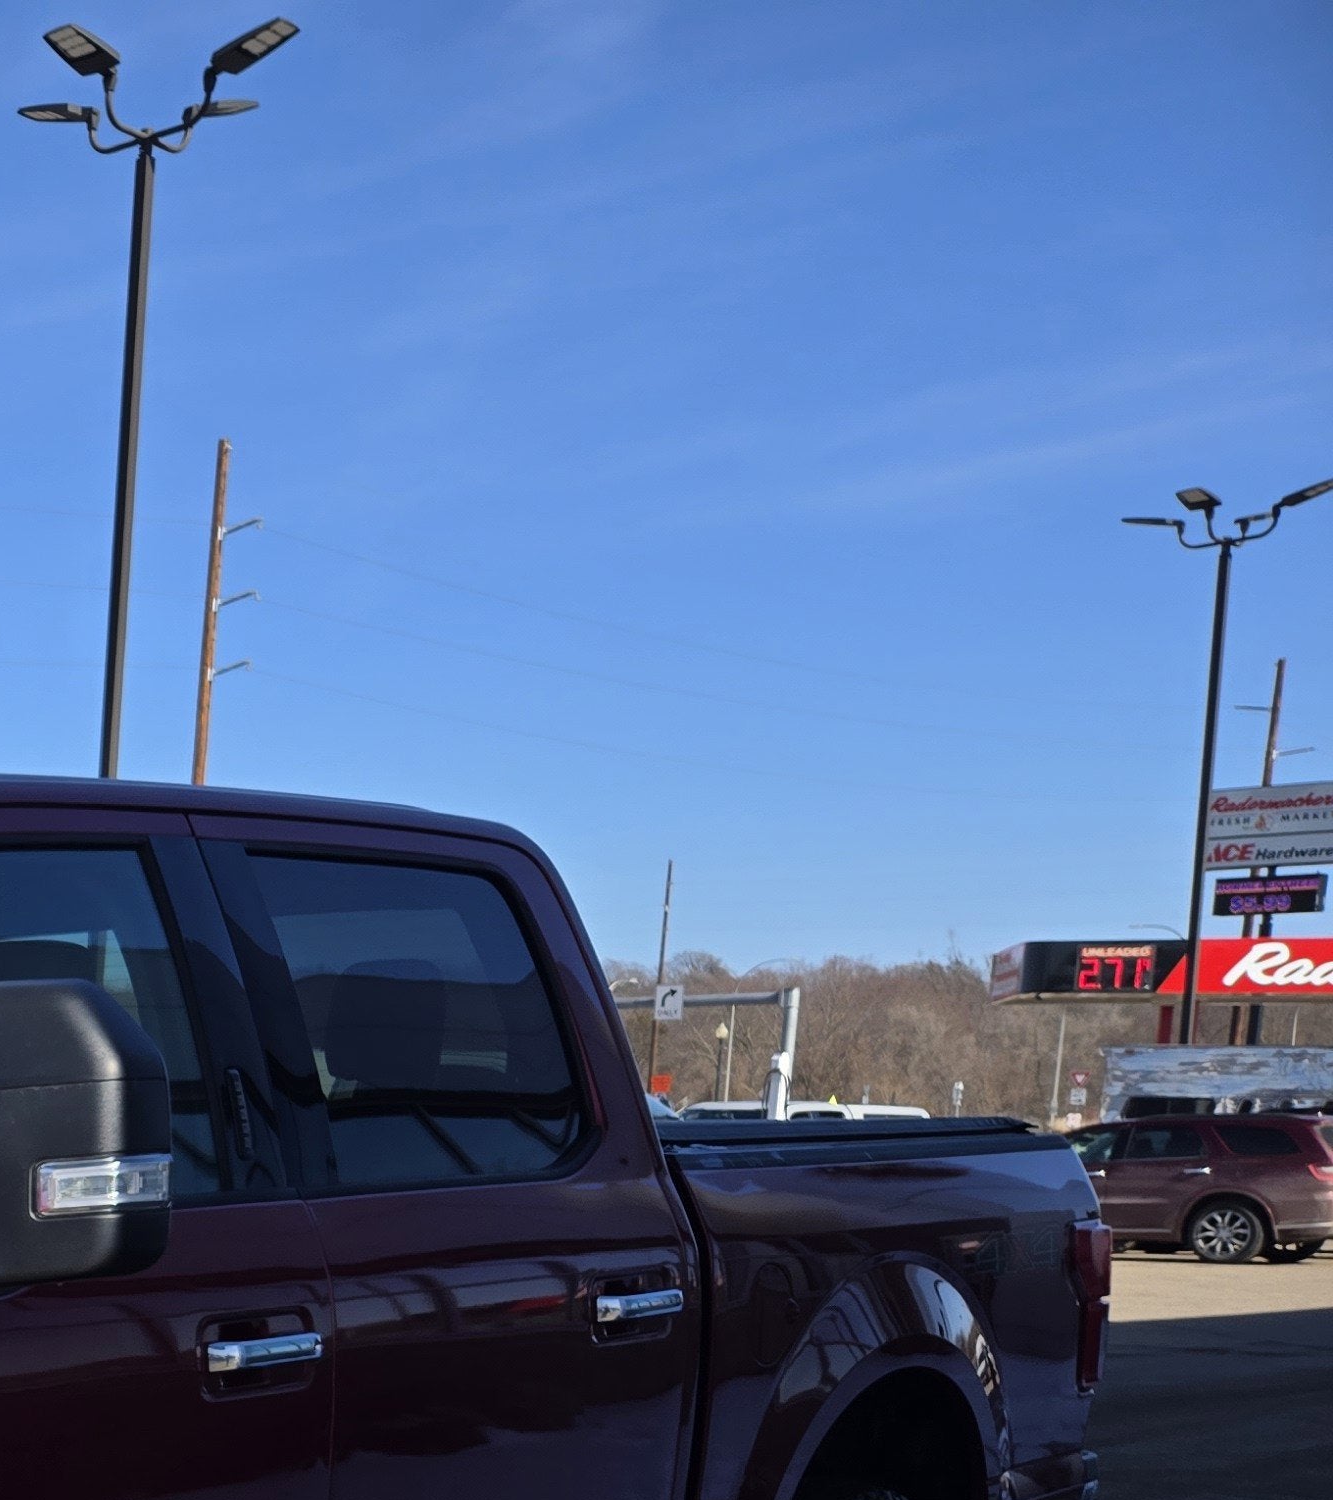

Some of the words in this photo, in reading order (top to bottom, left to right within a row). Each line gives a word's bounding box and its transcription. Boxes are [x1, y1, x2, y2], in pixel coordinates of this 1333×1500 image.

[1281, 810, 1333, 823] MARKE
[1207, 843, 1256, 862] ACE
[1255, 846, 1333, 860] Hardware
[1082, 945, 1152, 957] UNLEADED
